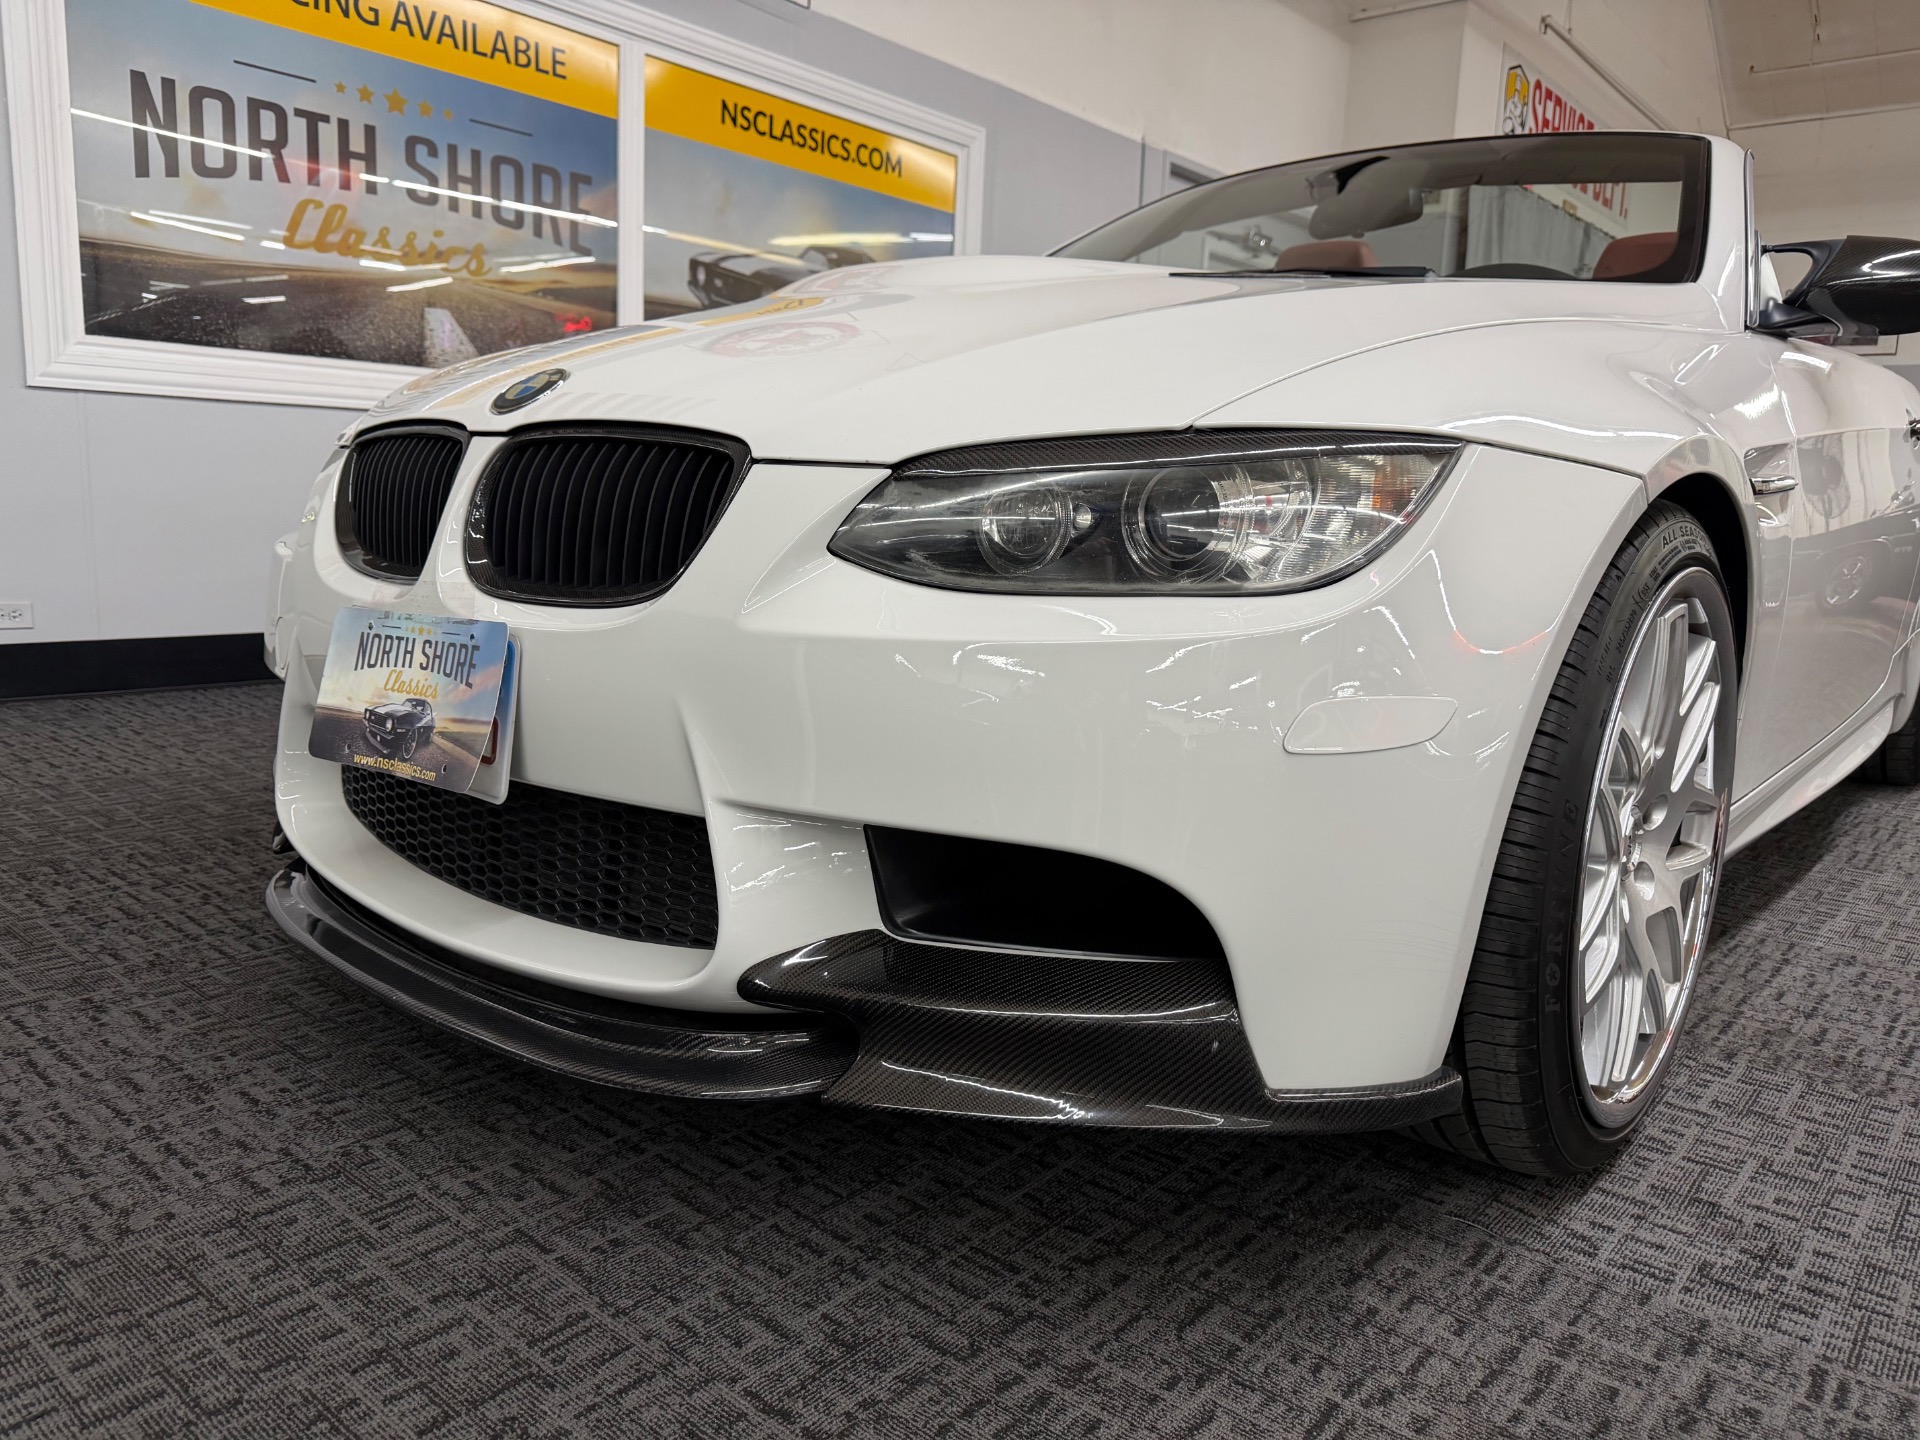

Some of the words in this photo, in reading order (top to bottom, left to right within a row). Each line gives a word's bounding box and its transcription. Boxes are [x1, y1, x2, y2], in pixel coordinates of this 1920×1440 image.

[390, 1, 567, 80] AVAILABLE
[130, 69, 377, 195] NORTH
[404, 135, 594, 257] SHORE
[721, 99, 903, 178] NSCLASSICS.COM
[282, 198, 491, 278] Classics
[1662, 529, 1678, 549] ALL
[354, 631, 418, 671] NORTH
[419, 639, 480, 689] SHORE
[383, 669, 438, 699] Classics
[353, 752, 437, 782] www.nsclassics.com
